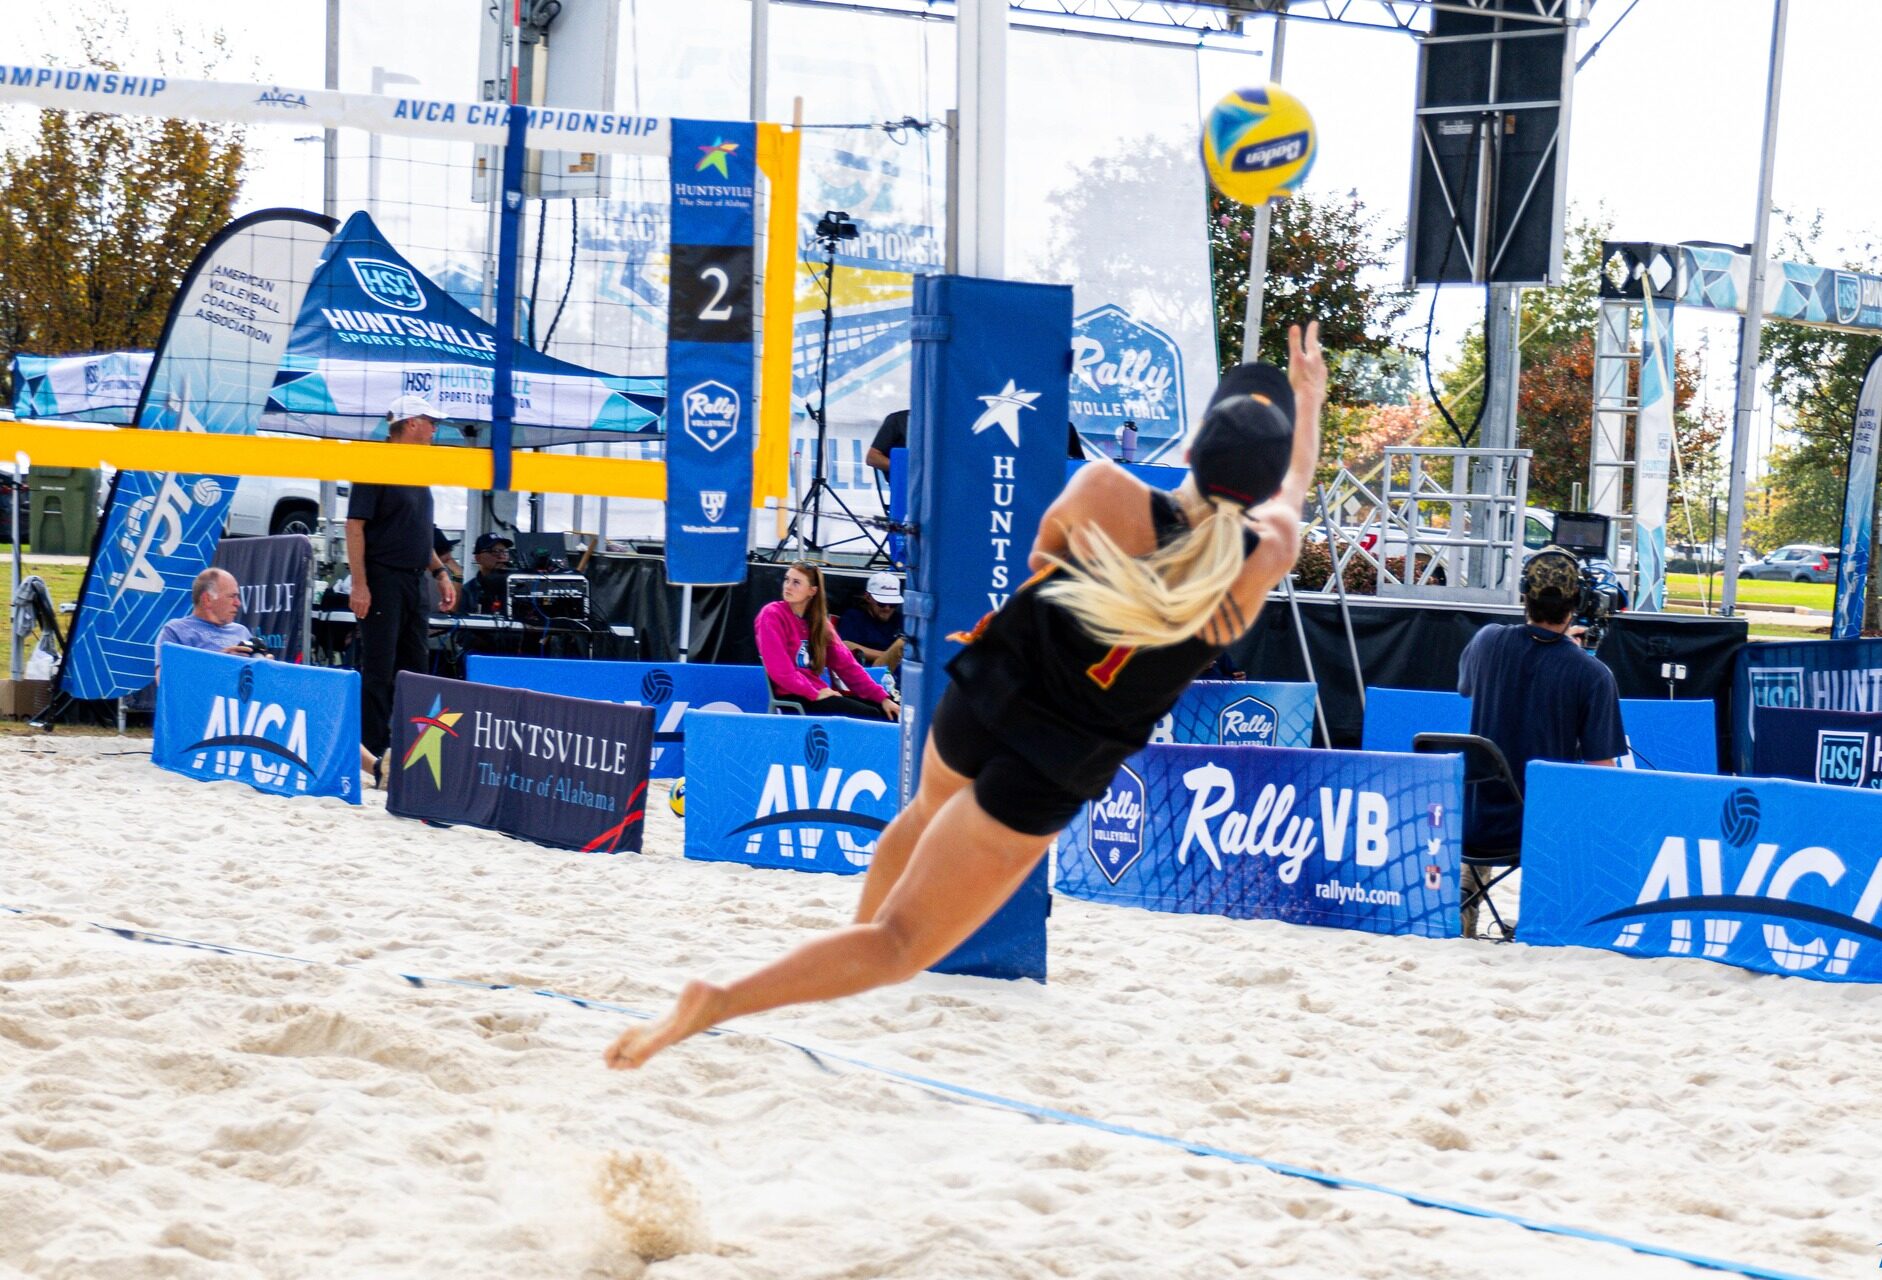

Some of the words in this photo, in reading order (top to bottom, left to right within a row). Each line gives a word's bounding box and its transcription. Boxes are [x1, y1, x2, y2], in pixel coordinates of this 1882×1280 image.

[394, 100, 456, 124] AVCA
[213, 264, 276, 293] AMERICAN
[361, 267, 420, 299] HSC
[201, 293, 257, 321] COACHES
[208, 279, 281, 314] VOLLEYBALL
[698, 266, 733, 321] 2
[194, 308, 273, 345] ASSOCIATION
[321, 308, 497, 353] HUNTSVILLE
[337, 331, 403, 347] SPORTS
[405, 371, 433, 393] HSC
[1071, 334, 1173, 403] Rally
[439, 392, 473, 405] SPORTS
[688, 392, 736, 420] Rally
[1072, 400, 1170, 421] VOLLEYBALL
[1223, 710, 1274, 738] Rally
[191, 695, 308, 791] AVCA
[473, 710, 628, 776] HUNTSVILLE
[1820, 745, 1862, 780] HSC
[536, 775, 554, 798] of
[553, 776, 616, 813] Alabama
[1093, 829, 1137, 844] VOLLEYBALL
[1315, 879, 1401, 906] rallyvb.com
